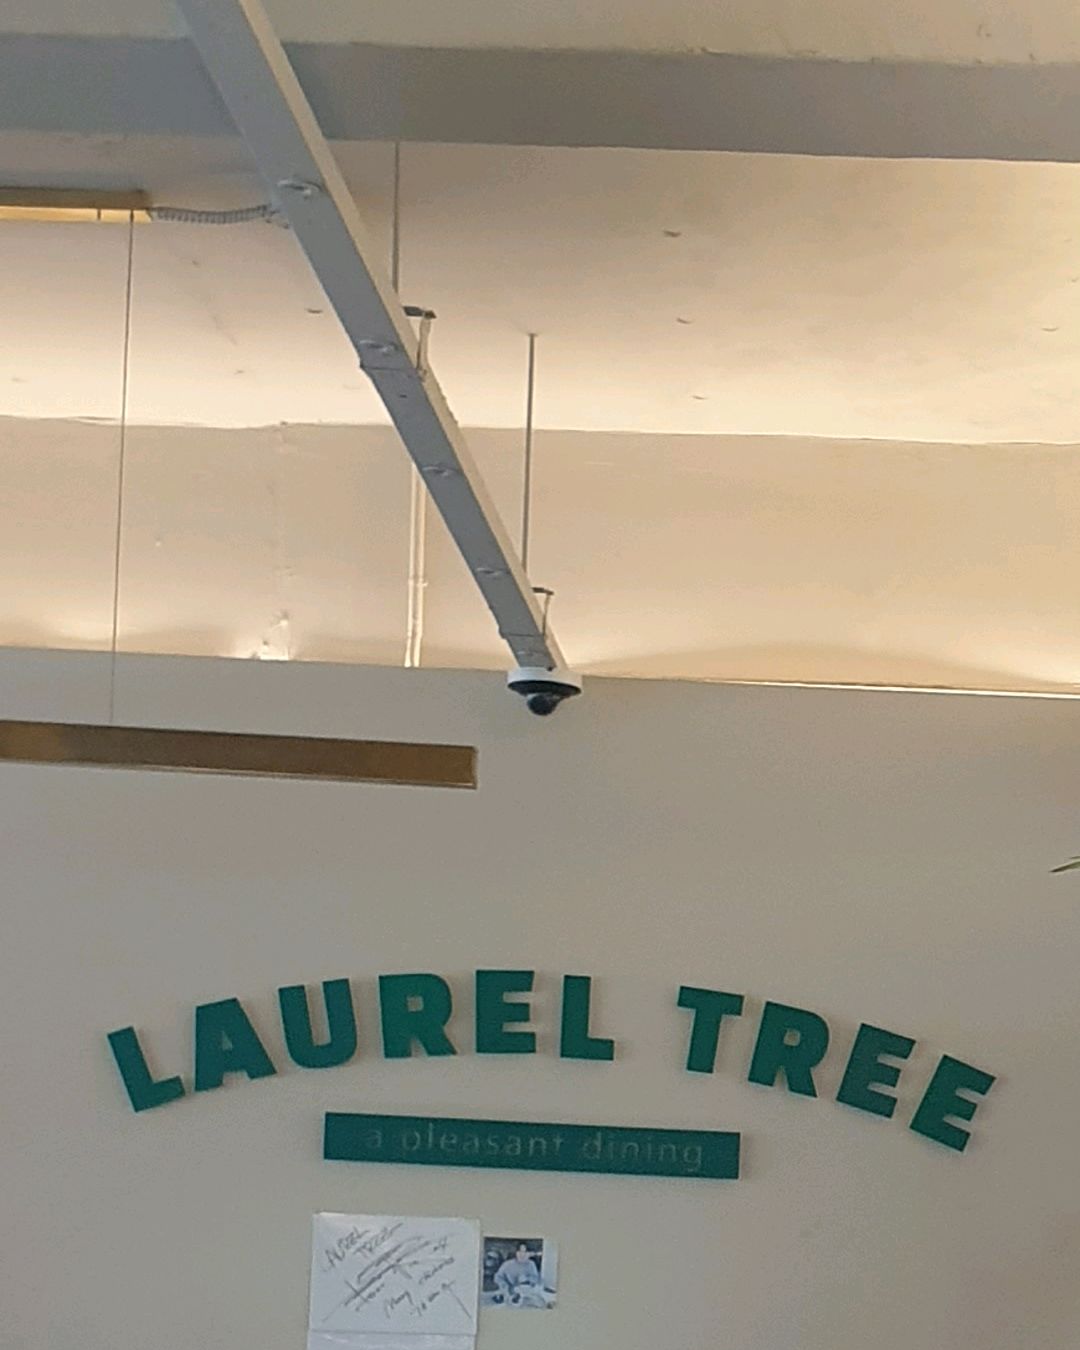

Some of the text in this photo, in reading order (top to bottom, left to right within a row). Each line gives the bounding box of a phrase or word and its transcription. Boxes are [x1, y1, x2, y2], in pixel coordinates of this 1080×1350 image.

[107, 969, 997, 1153] LAUREL TREE
[364, 1128, 384, 1150] a
[582, 1131, 702, 1172] dining
